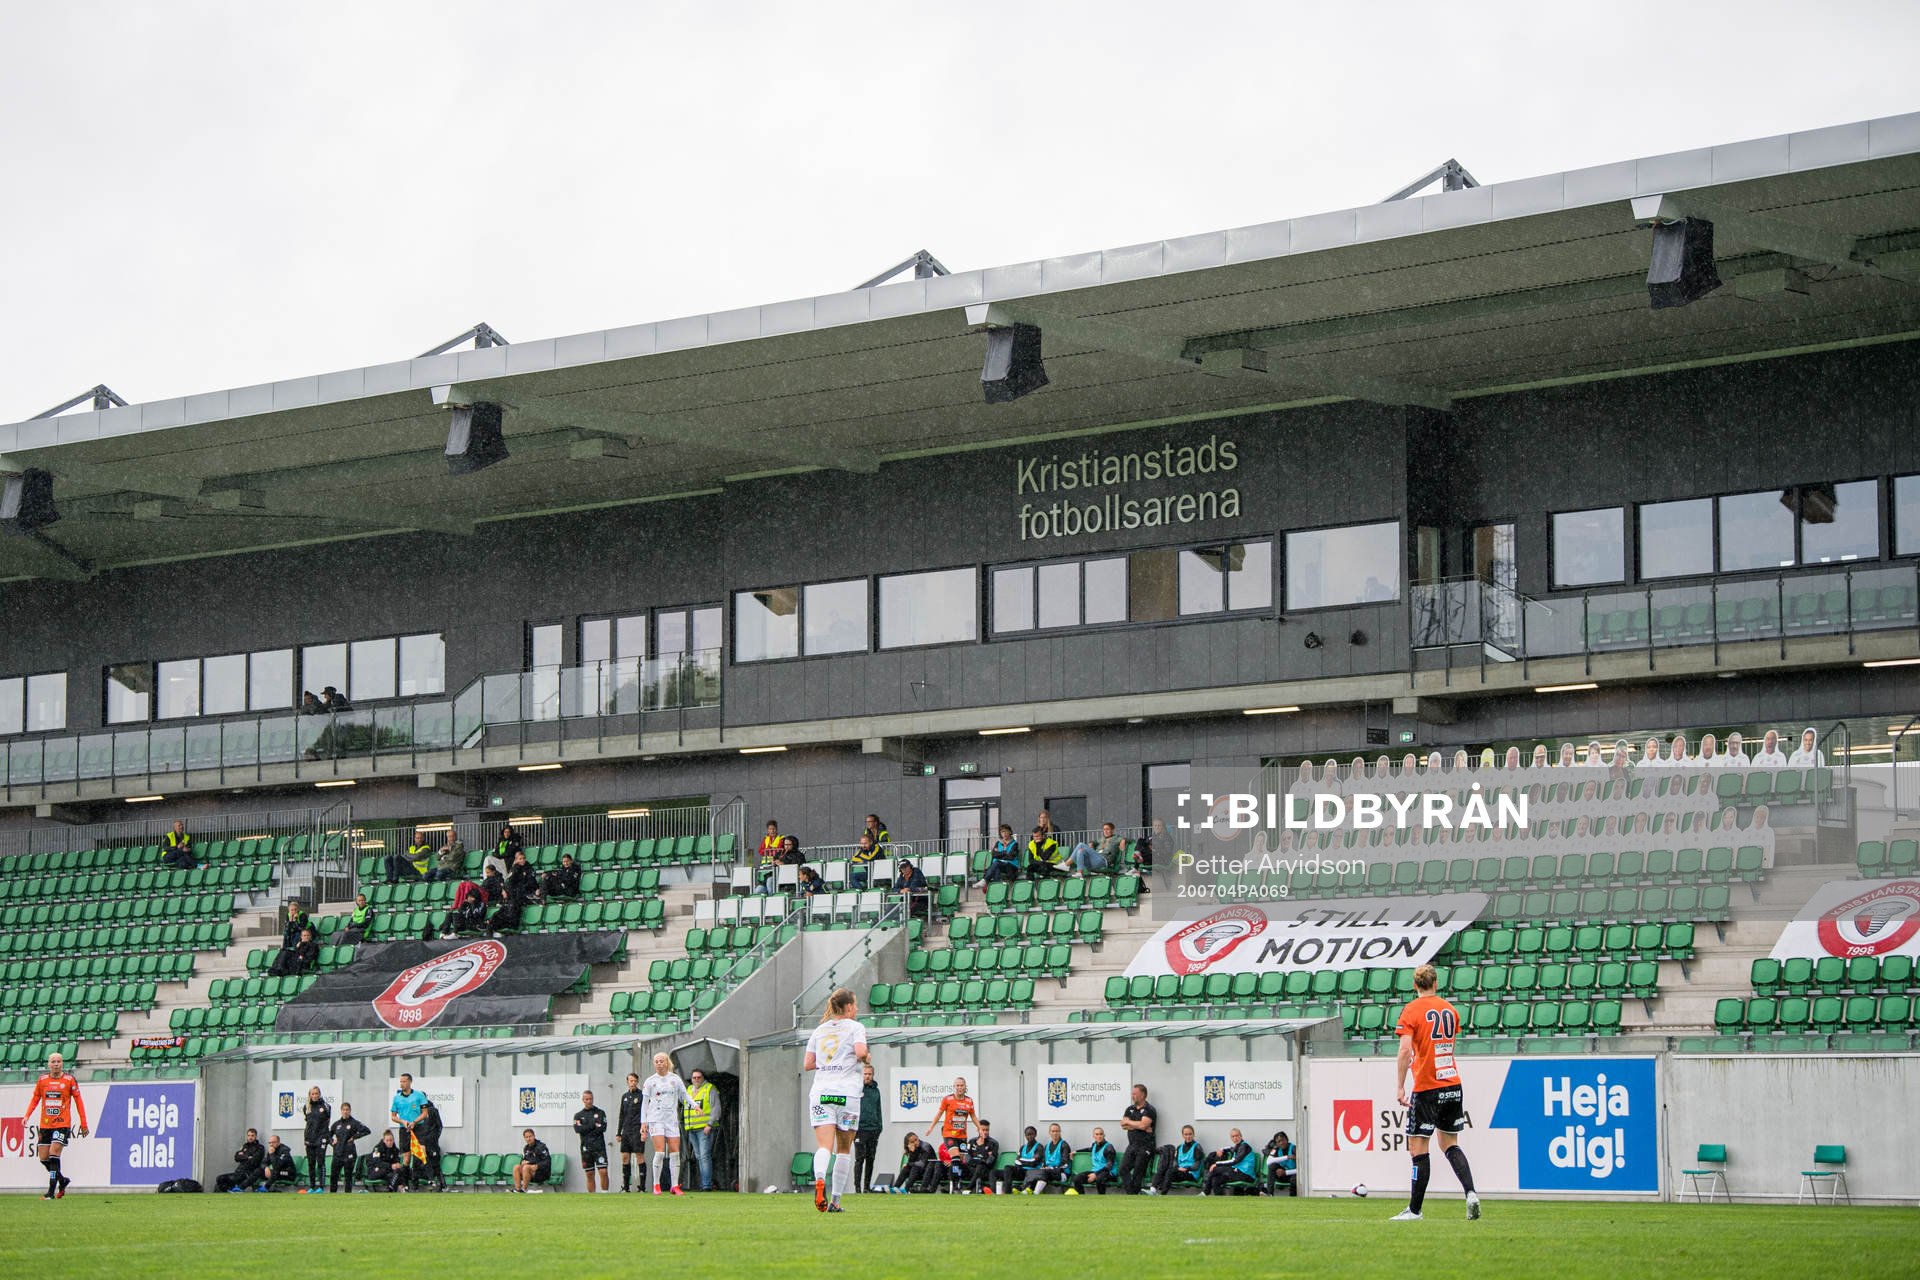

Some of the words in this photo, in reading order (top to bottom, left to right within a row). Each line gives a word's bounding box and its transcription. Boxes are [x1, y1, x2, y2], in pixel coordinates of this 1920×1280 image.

[1017, 434, 1239, 495] Kristianstads
[1018, 487, 1241, 541] fotbollsarena
[1288, 908, 1391, 928] STILL
[1403, 909, 1458, 928] IN
[1255, 935, 1429, 965] MOTION
[1845, 945, 1875, 956] 1998
[399, 1008, 422, 1023] 1998
[1425, 1008, 1455, 1040] 20
[821, 1033, 841, 1065] 9
[538, 1090, 580, 1100] Kristianstads
[1070, 1081, 1121, 1093] Kristianstads
[1070, 1092, 1105, 1103] kommun
[1229, 1079, 1283, 1091] Kristianstads
[1229, 1092, 1266, 1101] kommun
[538, 1101, 567, 1109] kommun
[1543, 1073, 1630, 1126] Heja
[127, 1094, 179, 1136] Heja
[129, 1135, 175, 1169] alla!
[1548, 1125, 1626, 1178] dig!
